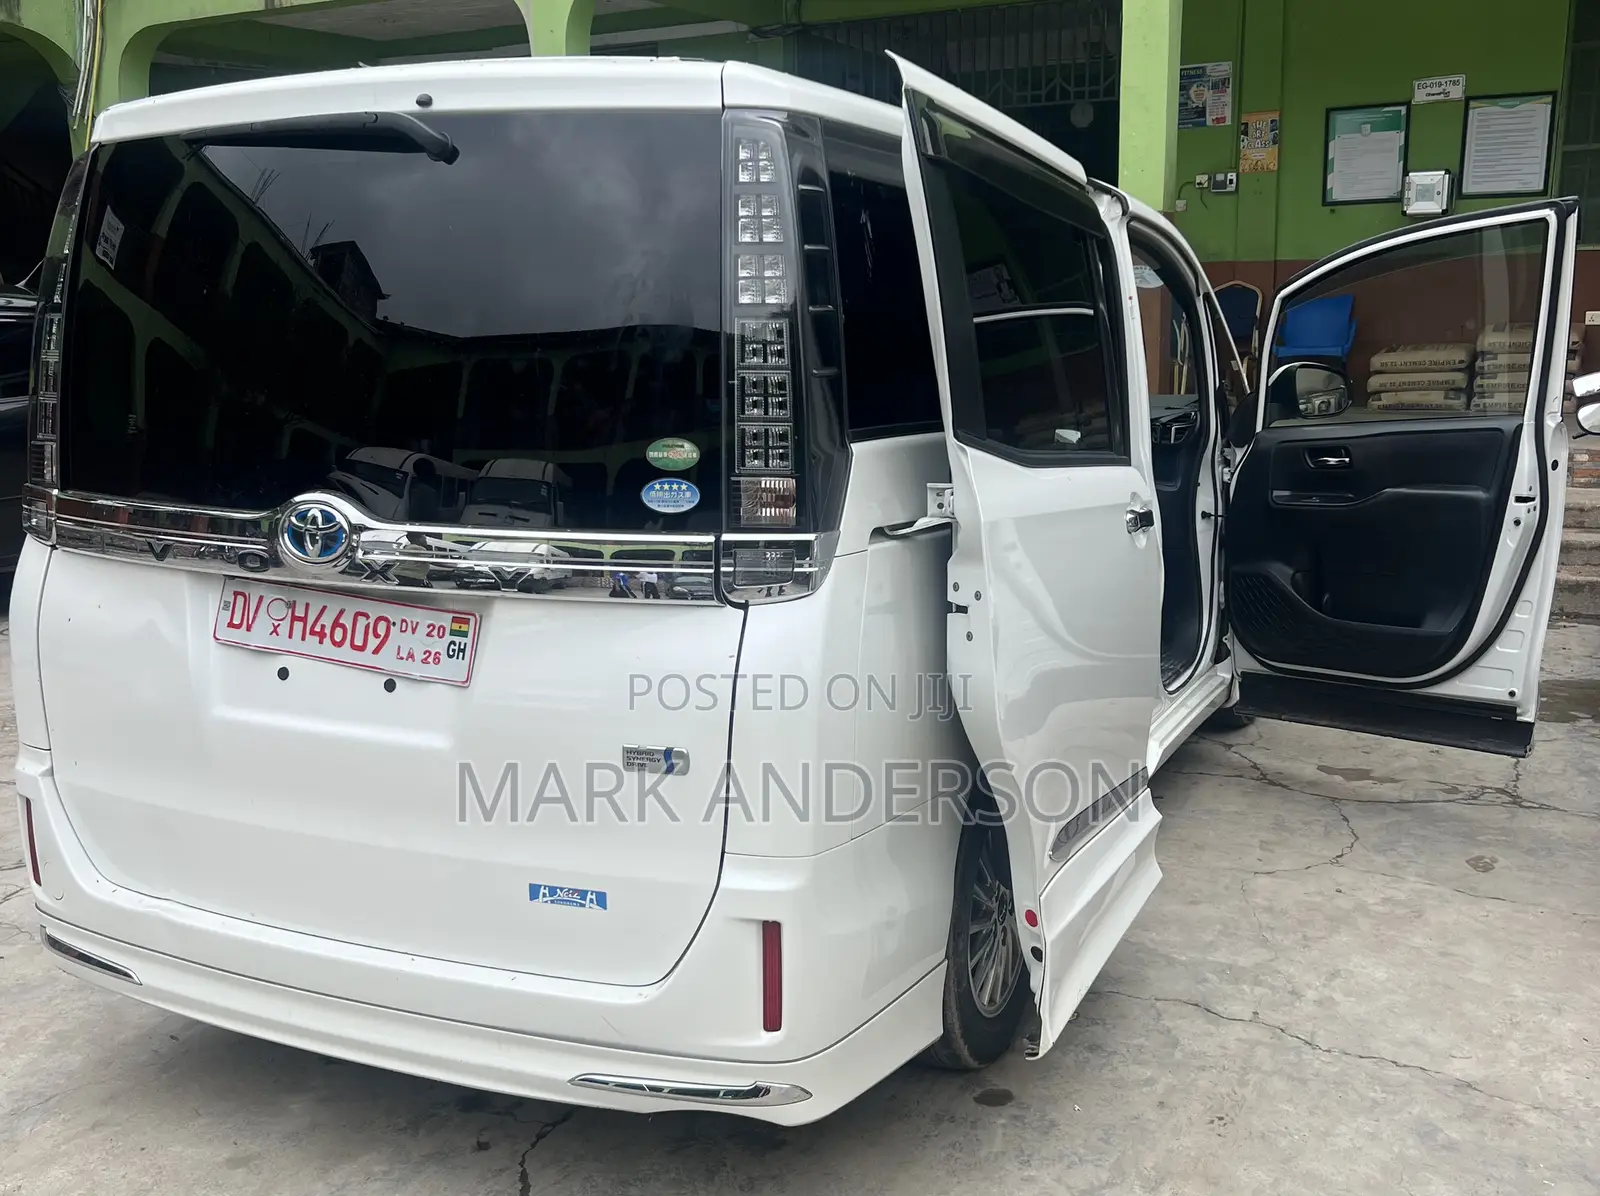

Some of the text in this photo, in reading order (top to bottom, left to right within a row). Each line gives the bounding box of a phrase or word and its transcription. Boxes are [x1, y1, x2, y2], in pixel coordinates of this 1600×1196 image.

[1252, 120, 1267, 129] THE
[1247, 140, 1270, 149] CLASS
[227, 590, 264, 632] DV
[400, 618, 446, 639] DV 20
[396, 645, 442, 666] LA 26
[447, 640, 468, 661] GH
